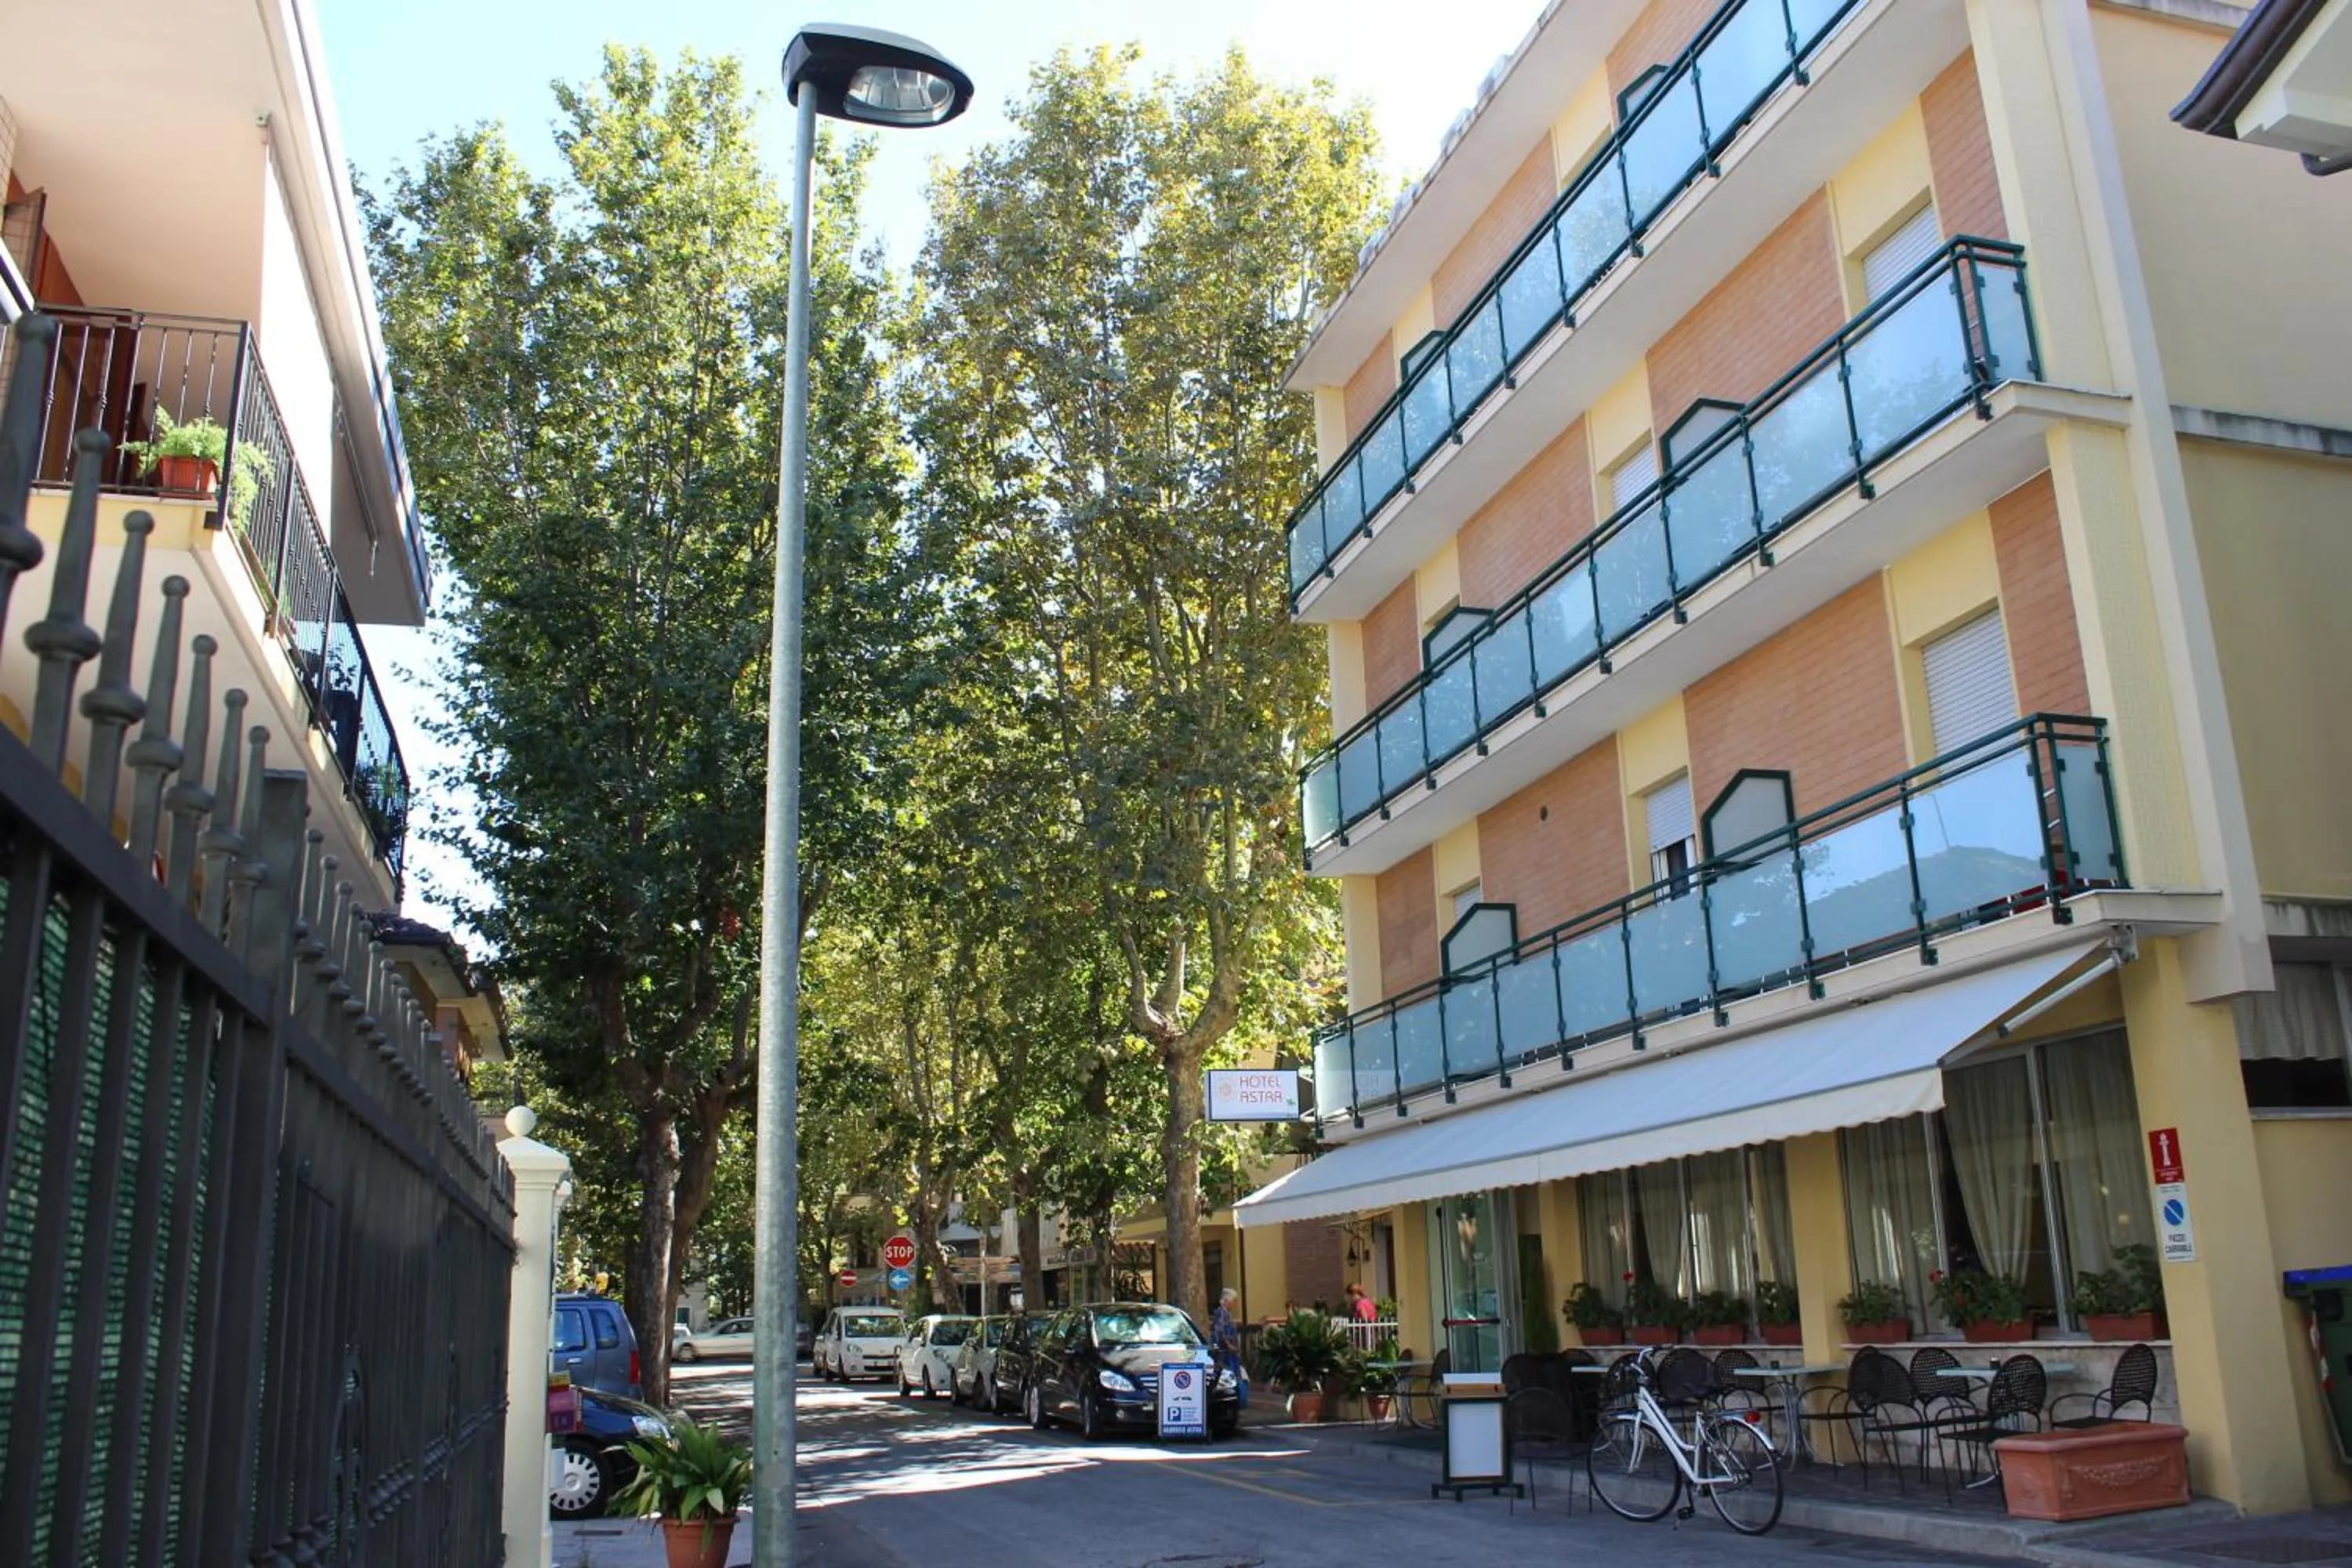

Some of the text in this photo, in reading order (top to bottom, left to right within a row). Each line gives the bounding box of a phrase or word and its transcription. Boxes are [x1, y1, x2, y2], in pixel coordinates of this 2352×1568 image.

[1240, 1075, 1279, 1088] HOTEL
[1240, 1091, 1283, 1103] ASTRA
[887, 1246, 913, 1258] STOP
[1169, 1407, 1179, 1421] P
